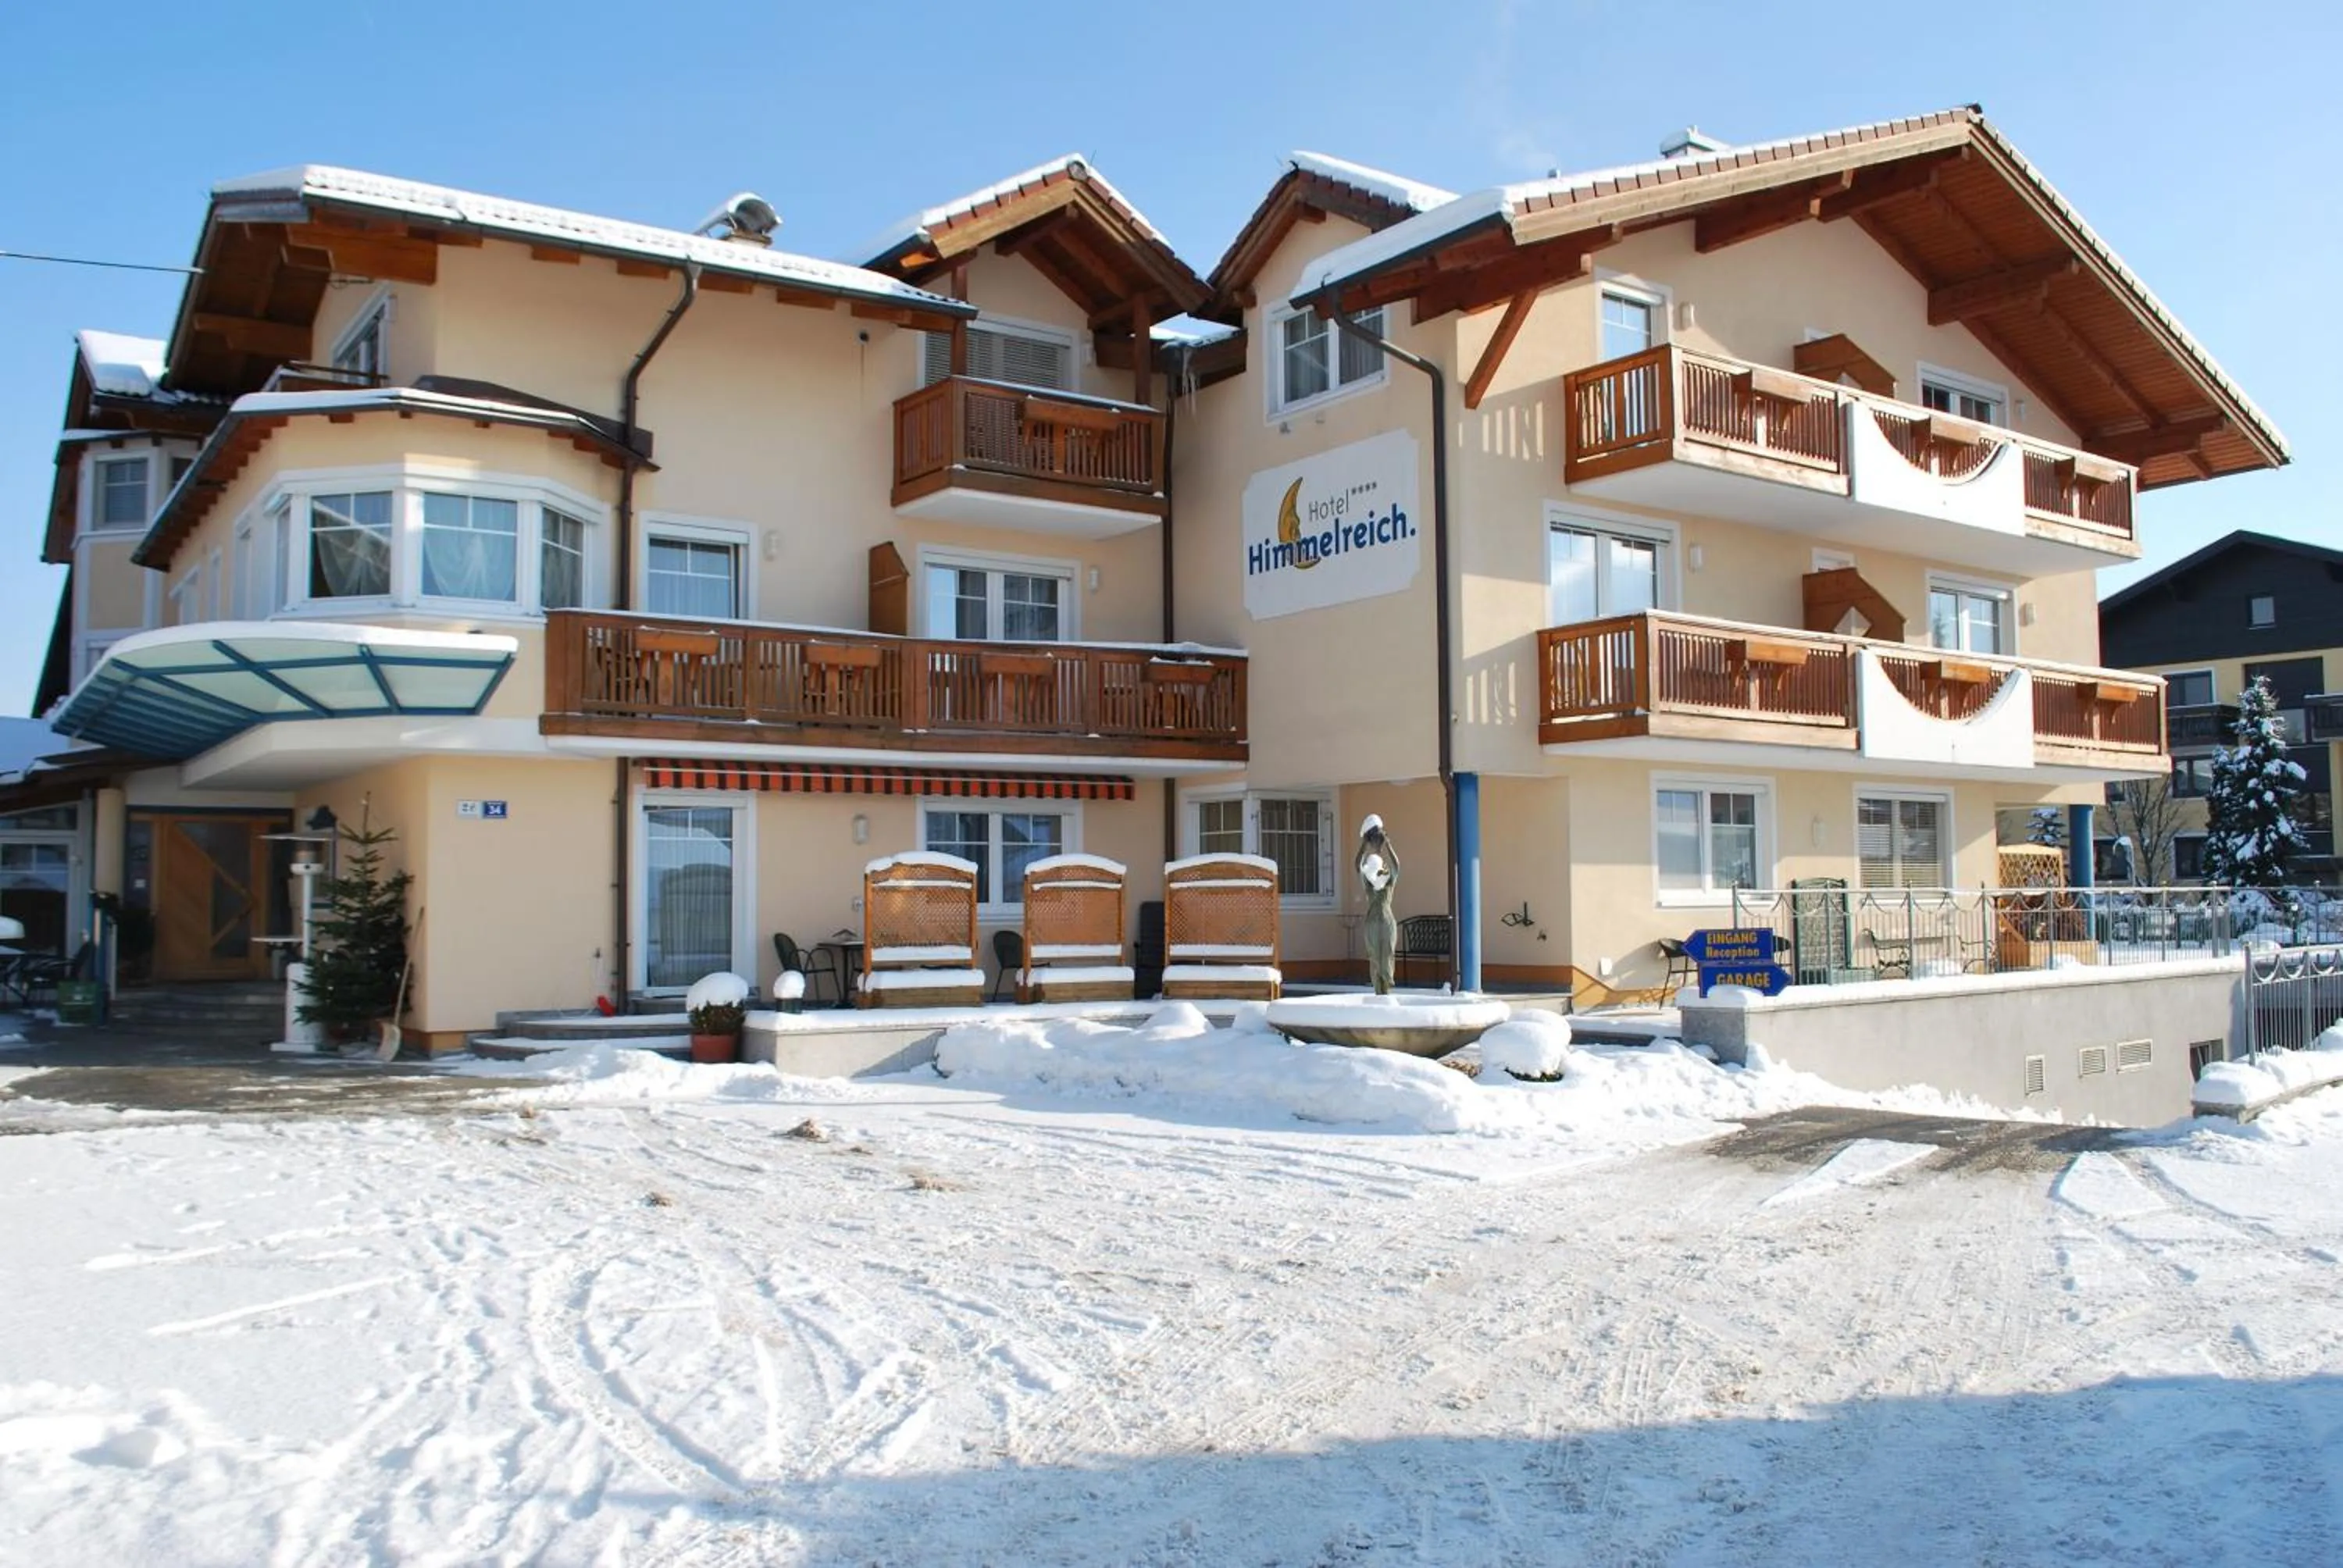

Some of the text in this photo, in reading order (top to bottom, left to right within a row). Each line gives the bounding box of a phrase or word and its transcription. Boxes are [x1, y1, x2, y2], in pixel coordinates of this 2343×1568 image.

[1307, 488, 1350, 522] Hotel
[1249, 502, 1416, 576] Himmelreich.
[1706, 932, 1758, 944] EINGANG
[1705, 946, 1760, 960] Reception
[1716, 972, 1771, 987] GARAGE
